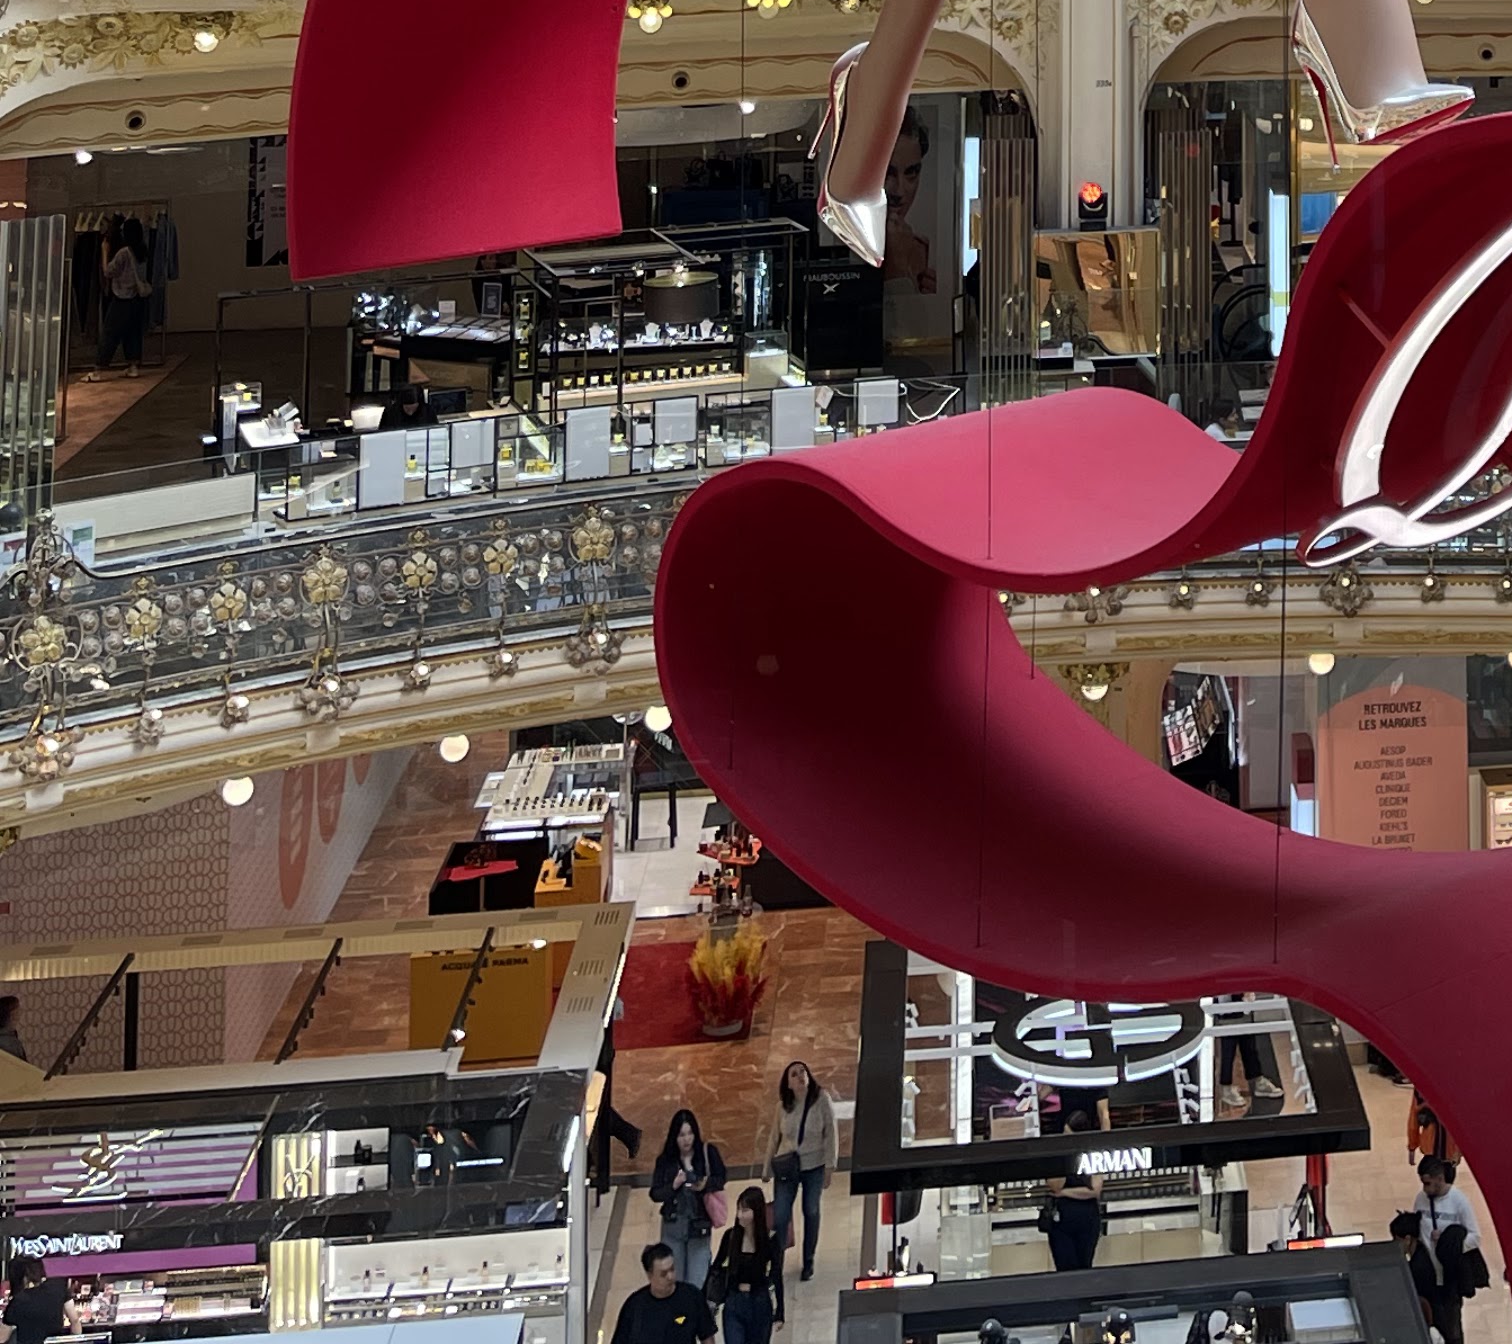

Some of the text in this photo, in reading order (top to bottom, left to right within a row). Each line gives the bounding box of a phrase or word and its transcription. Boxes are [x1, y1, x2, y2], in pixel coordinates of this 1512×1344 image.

[1363, 700, 1422, 716] RETROUVEZ
[1358, 716, 1427, 731] LES MARQUES
[1380, 745, 1407, 756] AESOP
[1076, 1146, 1153, 1176] ARMANI
